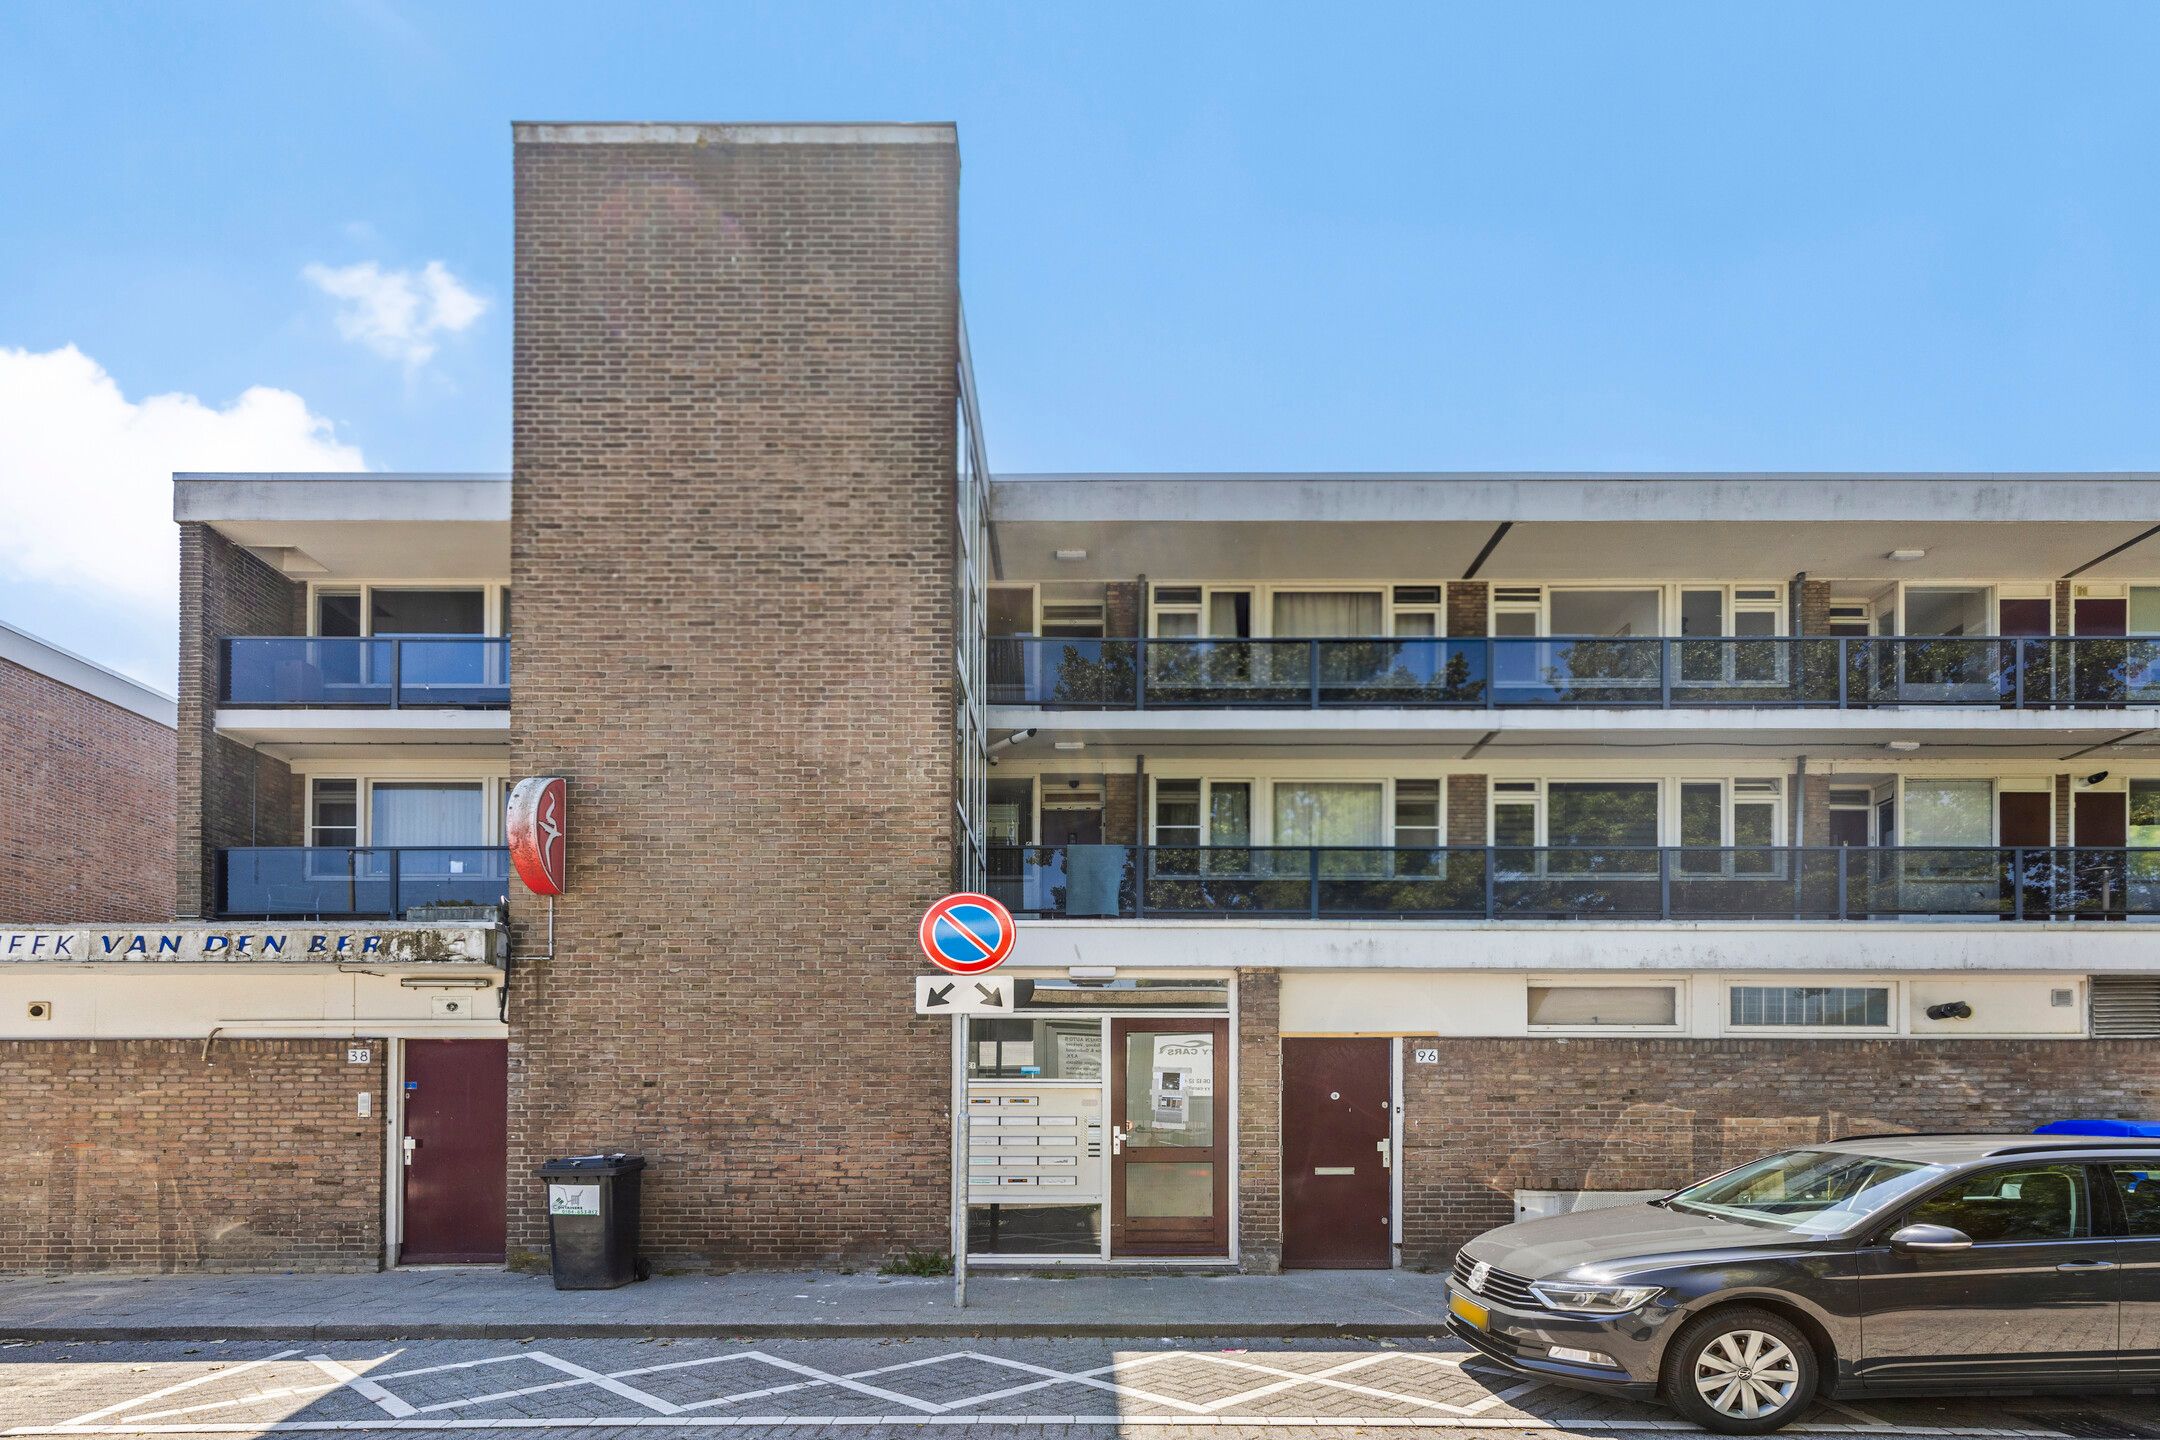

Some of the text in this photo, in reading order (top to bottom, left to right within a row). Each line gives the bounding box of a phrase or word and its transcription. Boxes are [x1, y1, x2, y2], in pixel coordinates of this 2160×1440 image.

[101, 935, 182, 954] VAN
[350, 1050, 368, 1062] 38
[1417, 1050, 1436, 1062] 96
